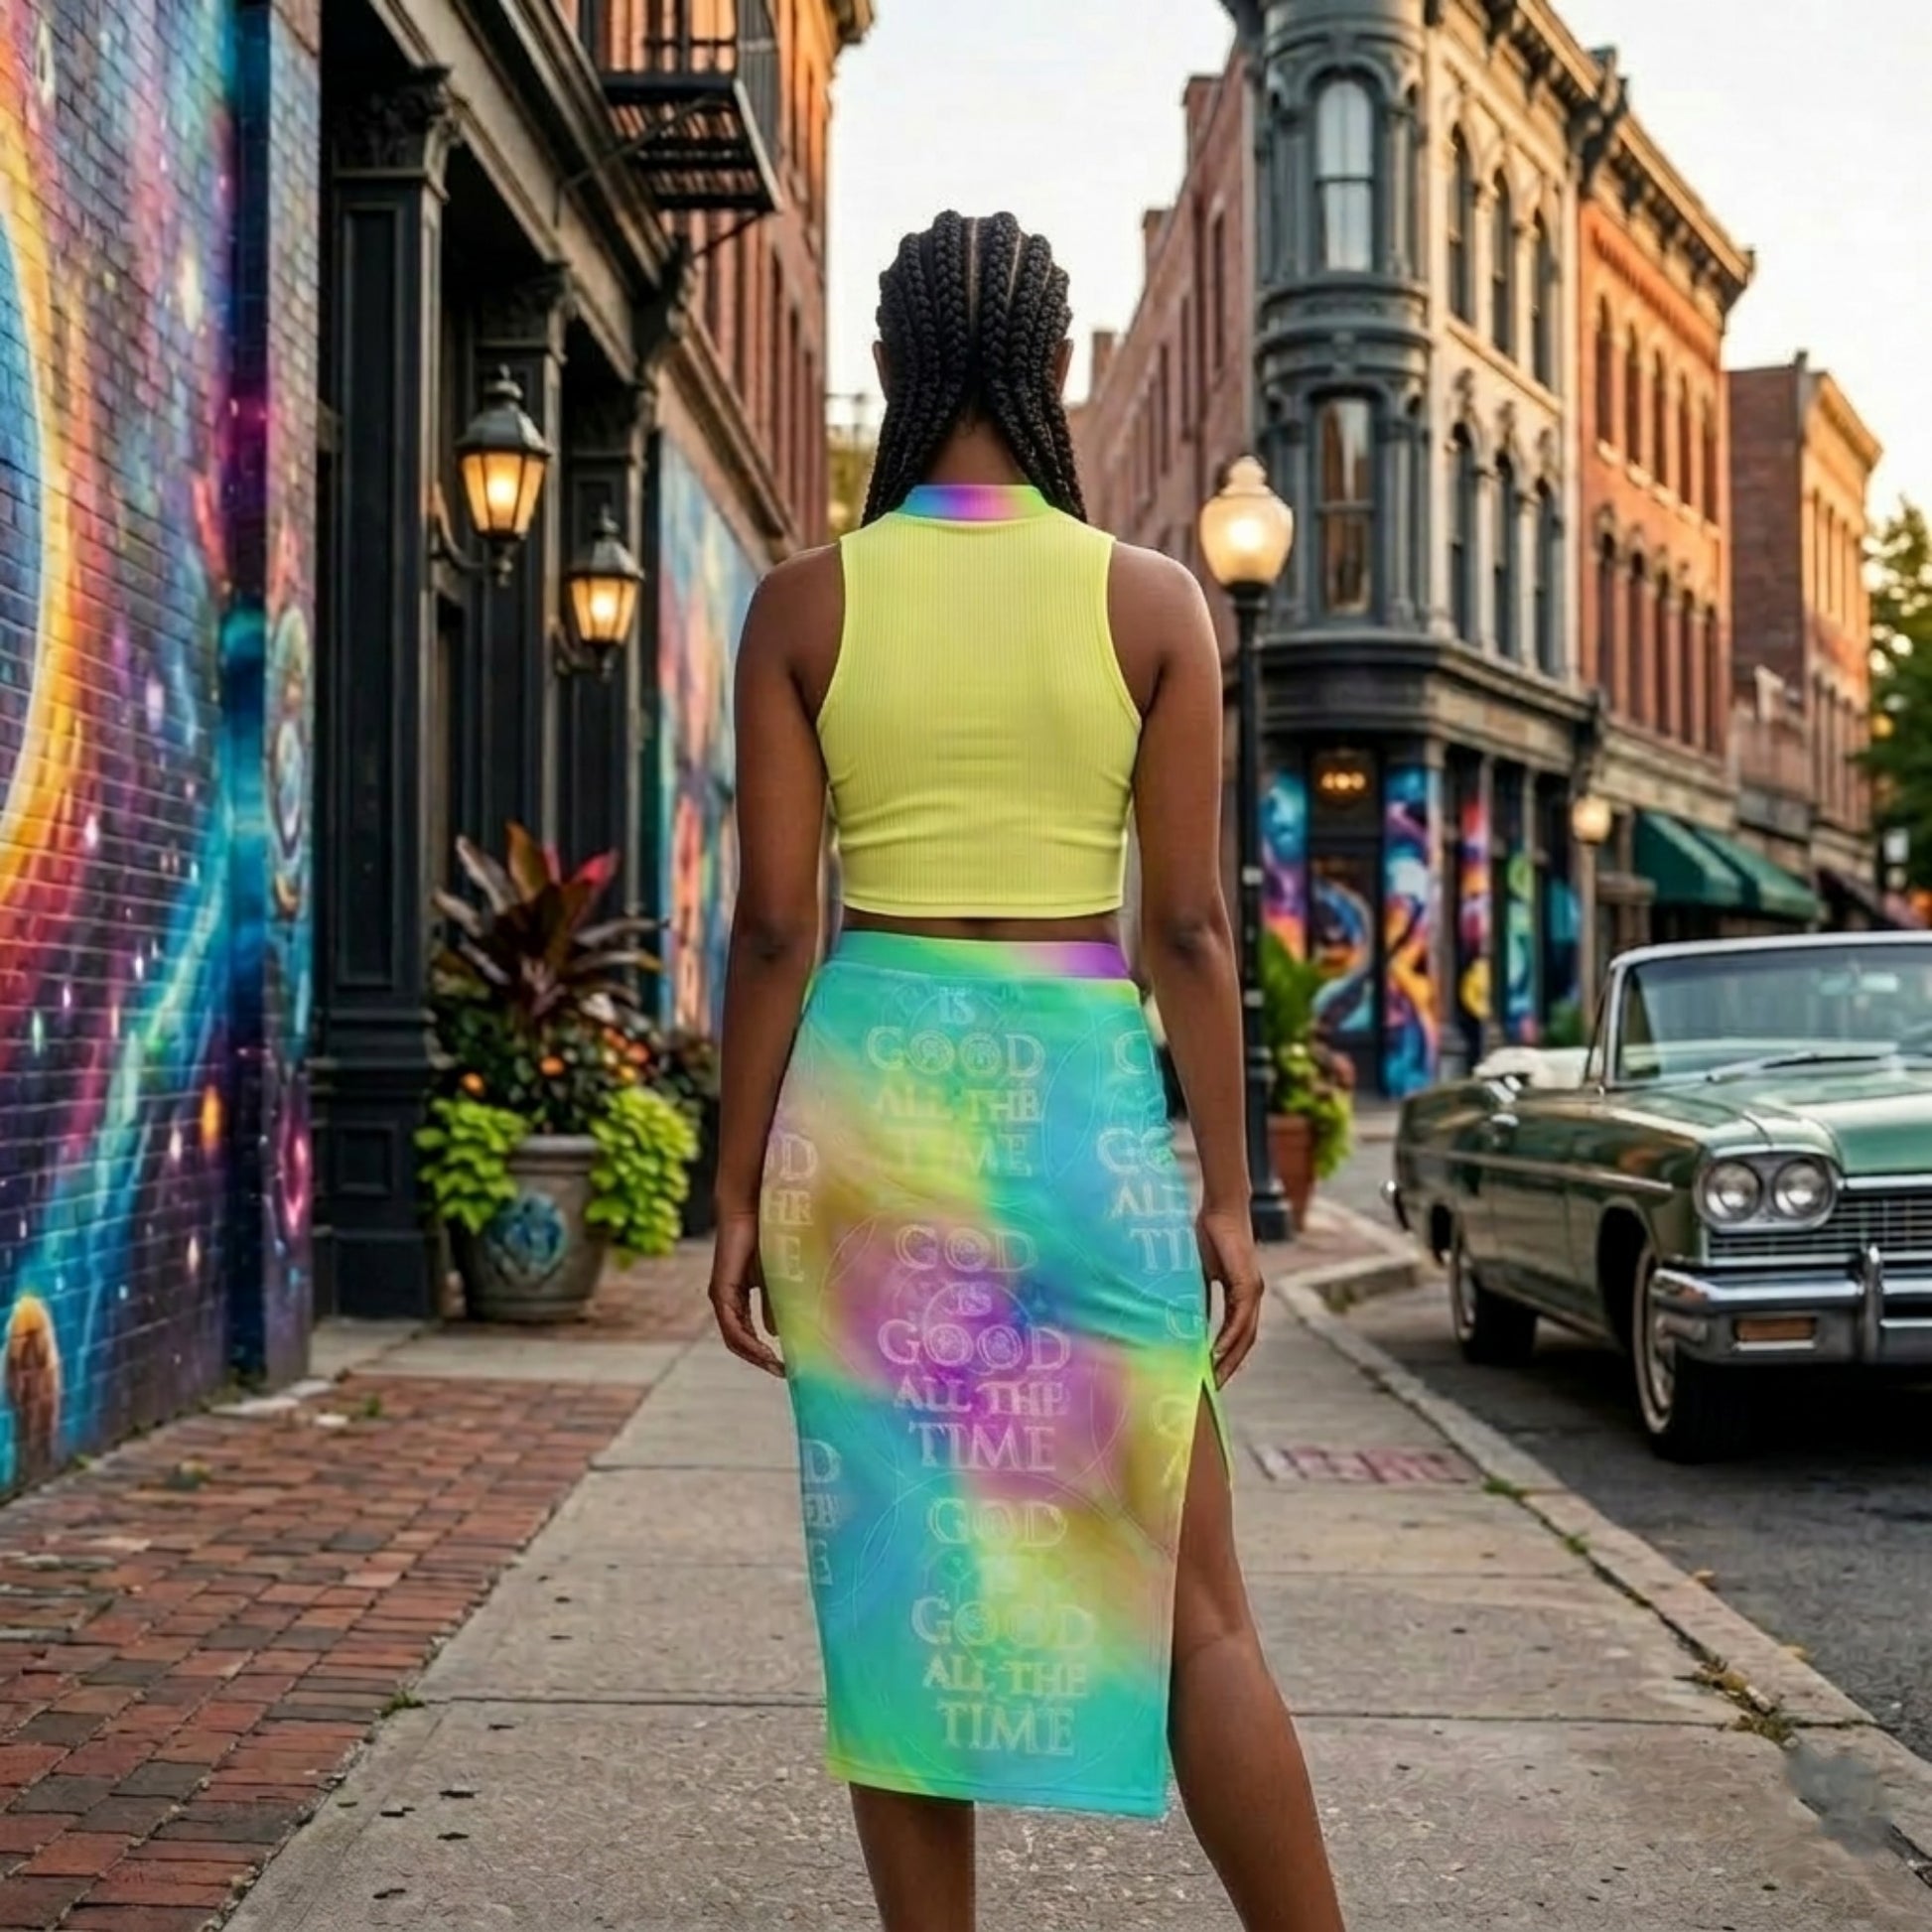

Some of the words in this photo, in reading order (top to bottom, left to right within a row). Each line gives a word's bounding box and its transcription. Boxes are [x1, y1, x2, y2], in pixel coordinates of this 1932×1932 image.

[940, 986, 976, 1025] IS
[960, 1088, 1043, 1122] THE
[877, 1317, 1072, 1371] GOOD
[894, 1373, 973, 1413] ALL
[975, 1379, 1071, 1417] THE
[907, 1420, 1057, 1471] TIME
[926, 1496, 1068, 1549] GOD
[910, 1594, 1096, 1649] GOOD
[922, 1653, 996, 1691] ALL
[1001, 1659, 1088, 1699] THE
[937, 1702, 1075, 1756] TIME
